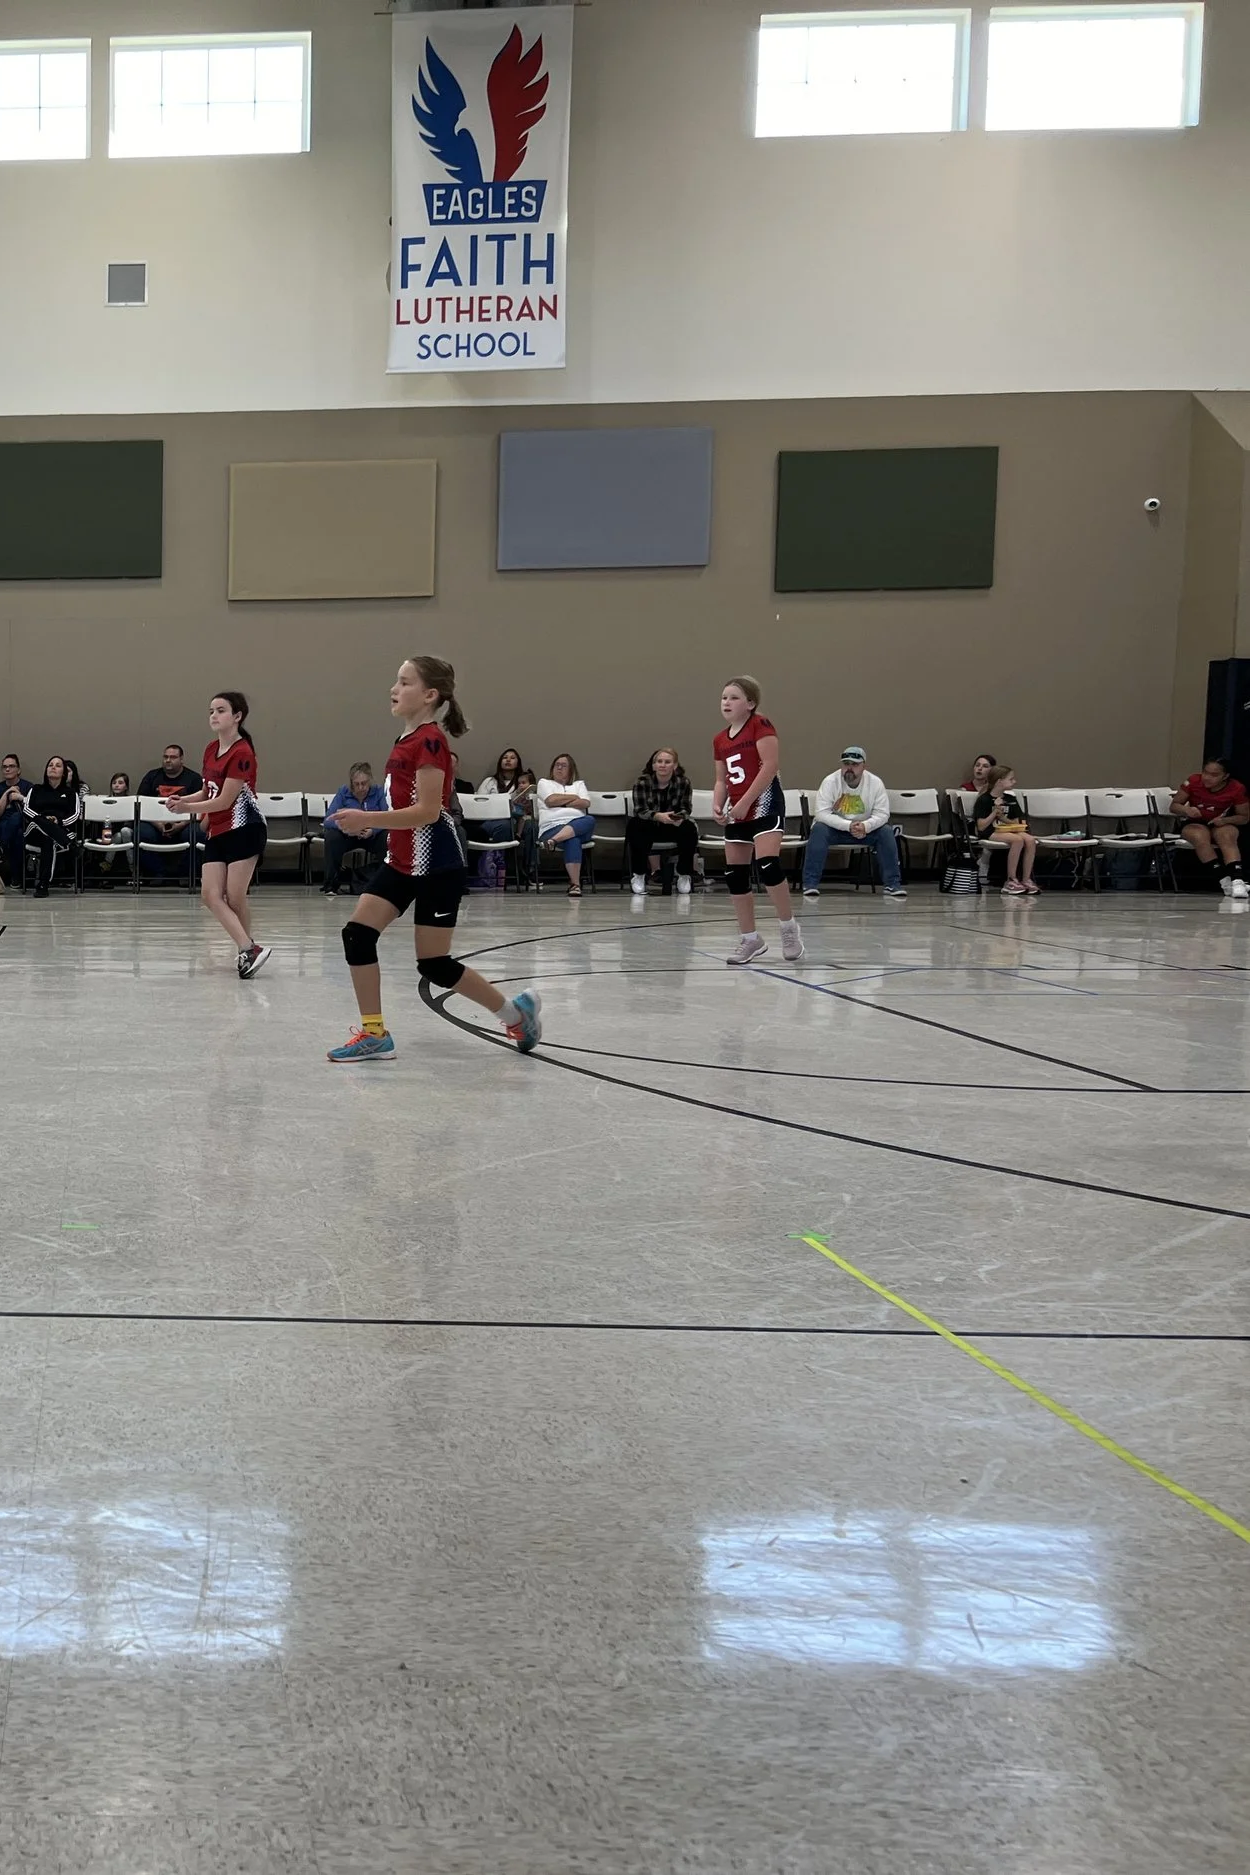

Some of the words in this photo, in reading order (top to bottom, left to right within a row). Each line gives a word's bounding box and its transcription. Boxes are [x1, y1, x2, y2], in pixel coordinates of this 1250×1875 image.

[432, 186, 537, 220] EAGLES
[400, 233, 555, 289] FAITH
[395, 294, 558, 325] LUTHERAN
[416, 332, 536, 360] SCHOOL
[726, 753, 746, 785] 5
